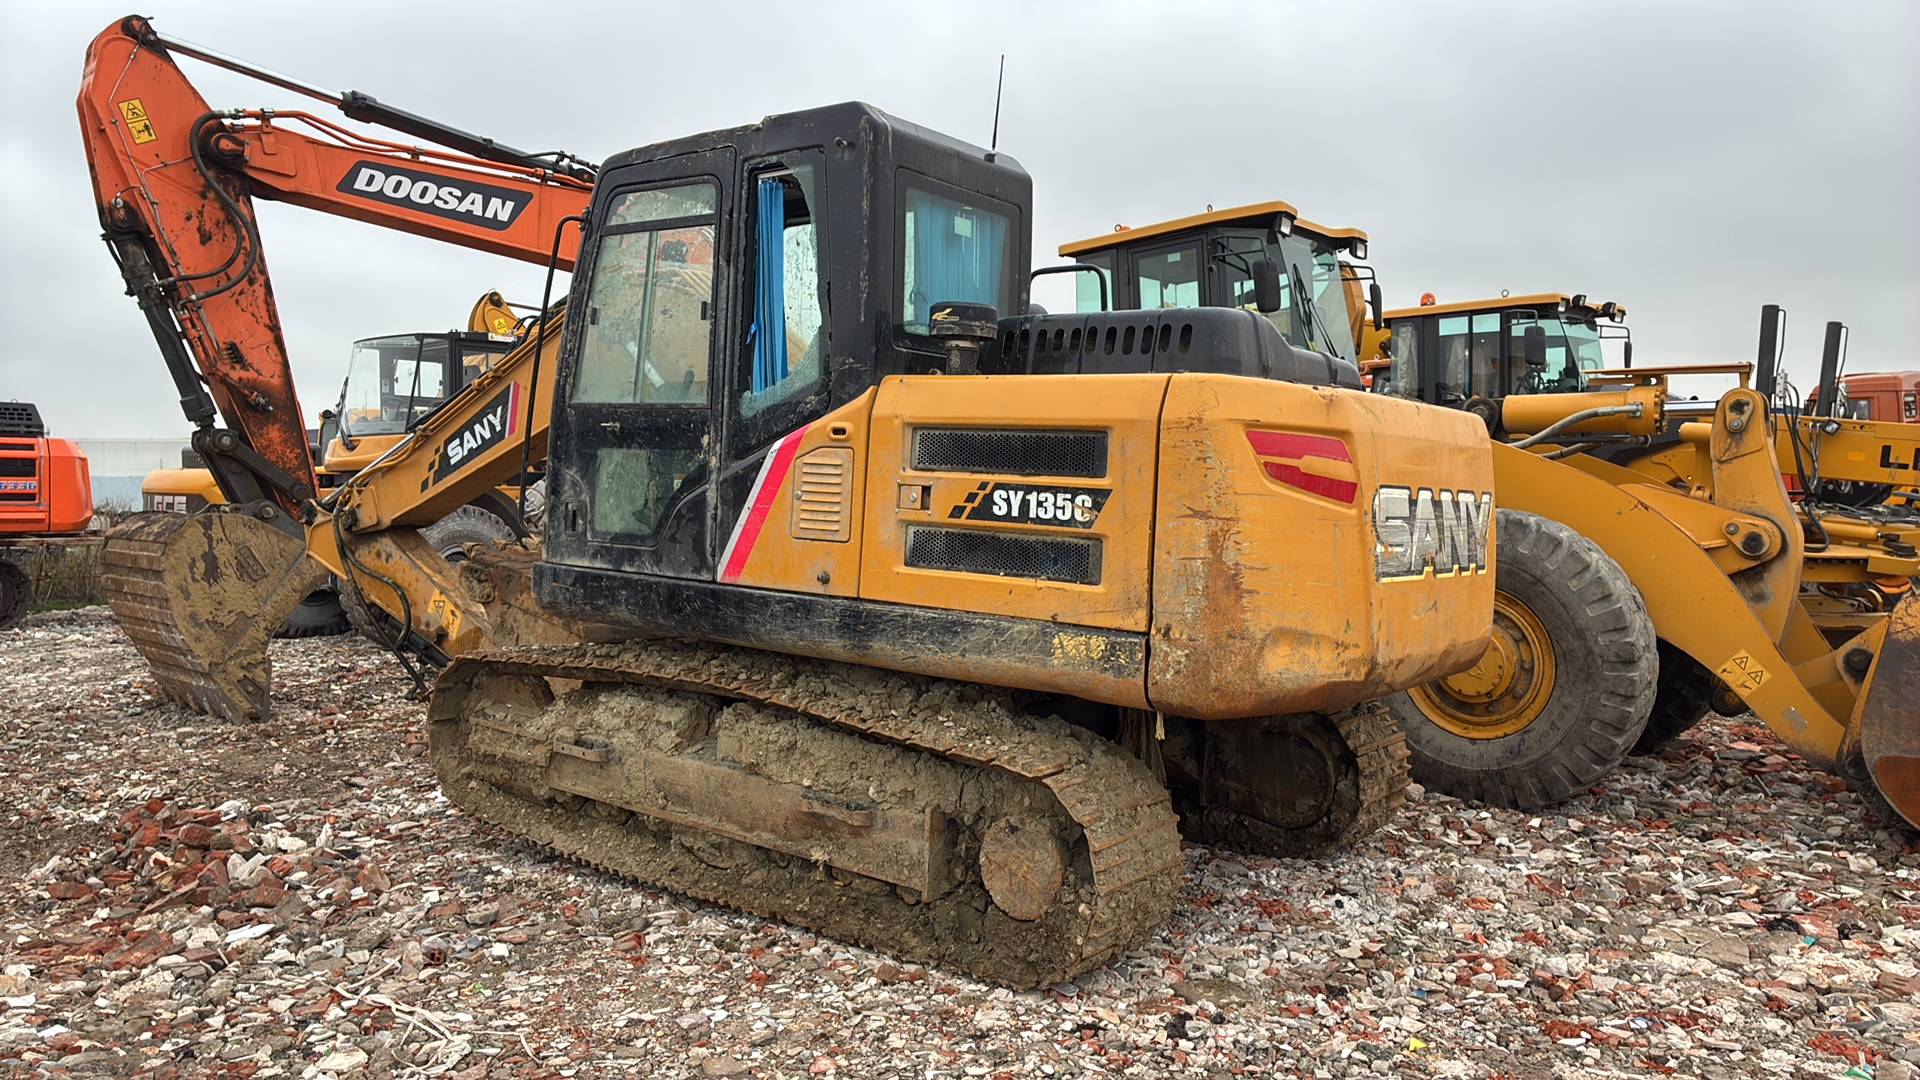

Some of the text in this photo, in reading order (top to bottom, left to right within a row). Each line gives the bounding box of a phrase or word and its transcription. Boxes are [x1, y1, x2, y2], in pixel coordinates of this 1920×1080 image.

[353, 167, 515, 222] DOOSAN
[446, 405, 503, 466] SANY
[1879, 444, 1920, 472] L
[1372, 485, 1492, 583] SANY
